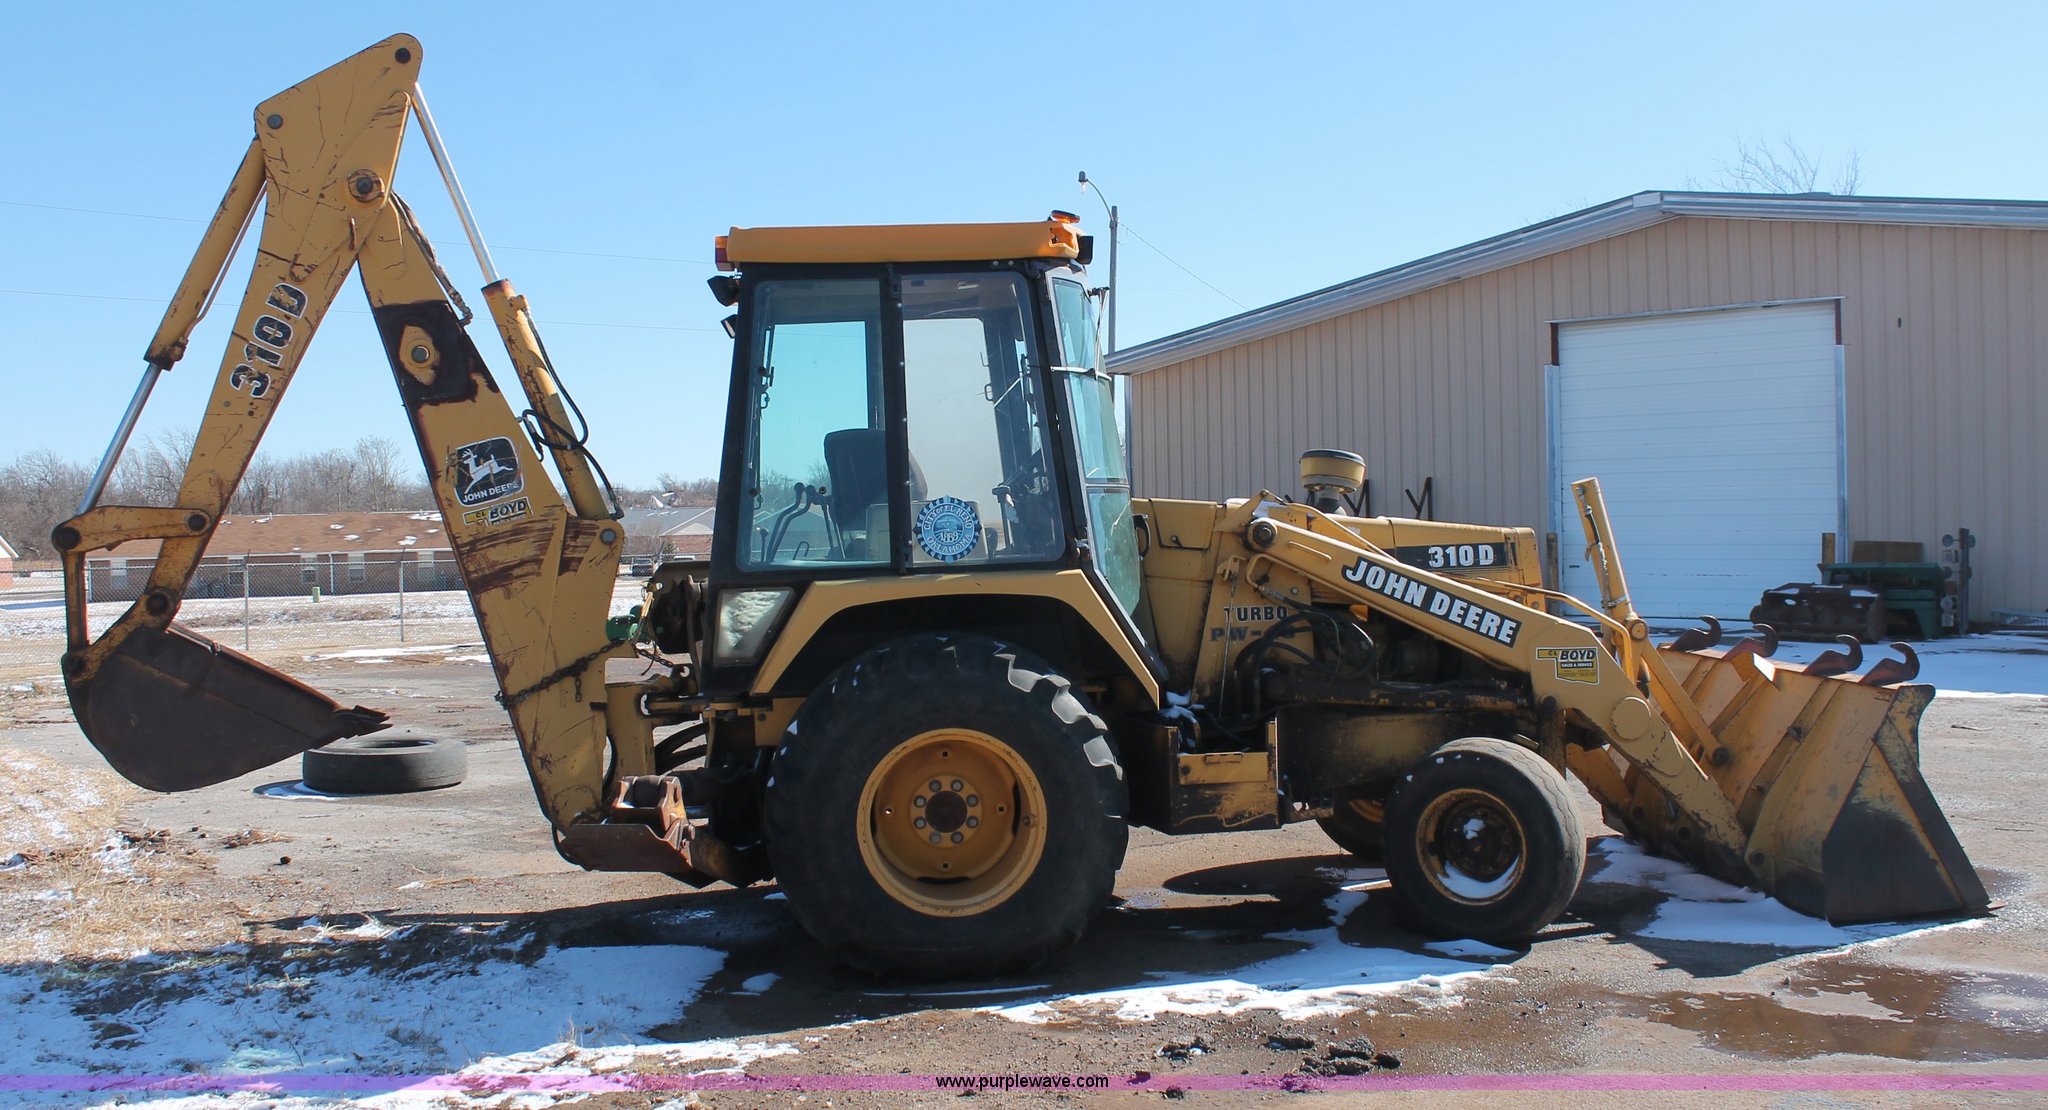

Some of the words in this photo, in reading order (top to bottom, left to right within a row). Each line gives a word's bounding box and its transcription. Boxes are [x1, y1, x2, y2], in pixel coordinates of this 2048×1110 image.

[230, 282, 308, 398] 310D
[463, 490, 488, 503] JOHN
[488, 482, 520, 496] DEERE
[489, 500, 526, 519] BOYD
[923, 510, 937, 530] CITY
[944, 505, 955, 513] EL
[956, 508, 972, 529] RENO
[927, 535, 971, 553] OKLAHOMA
[1345, 559, 1428, 608] JOHN
[1429, 590, 1518, 645] DEERE
[1223, 605, 1288, 624] TURBO
[1559, 650, 1596, 661] BOYD
